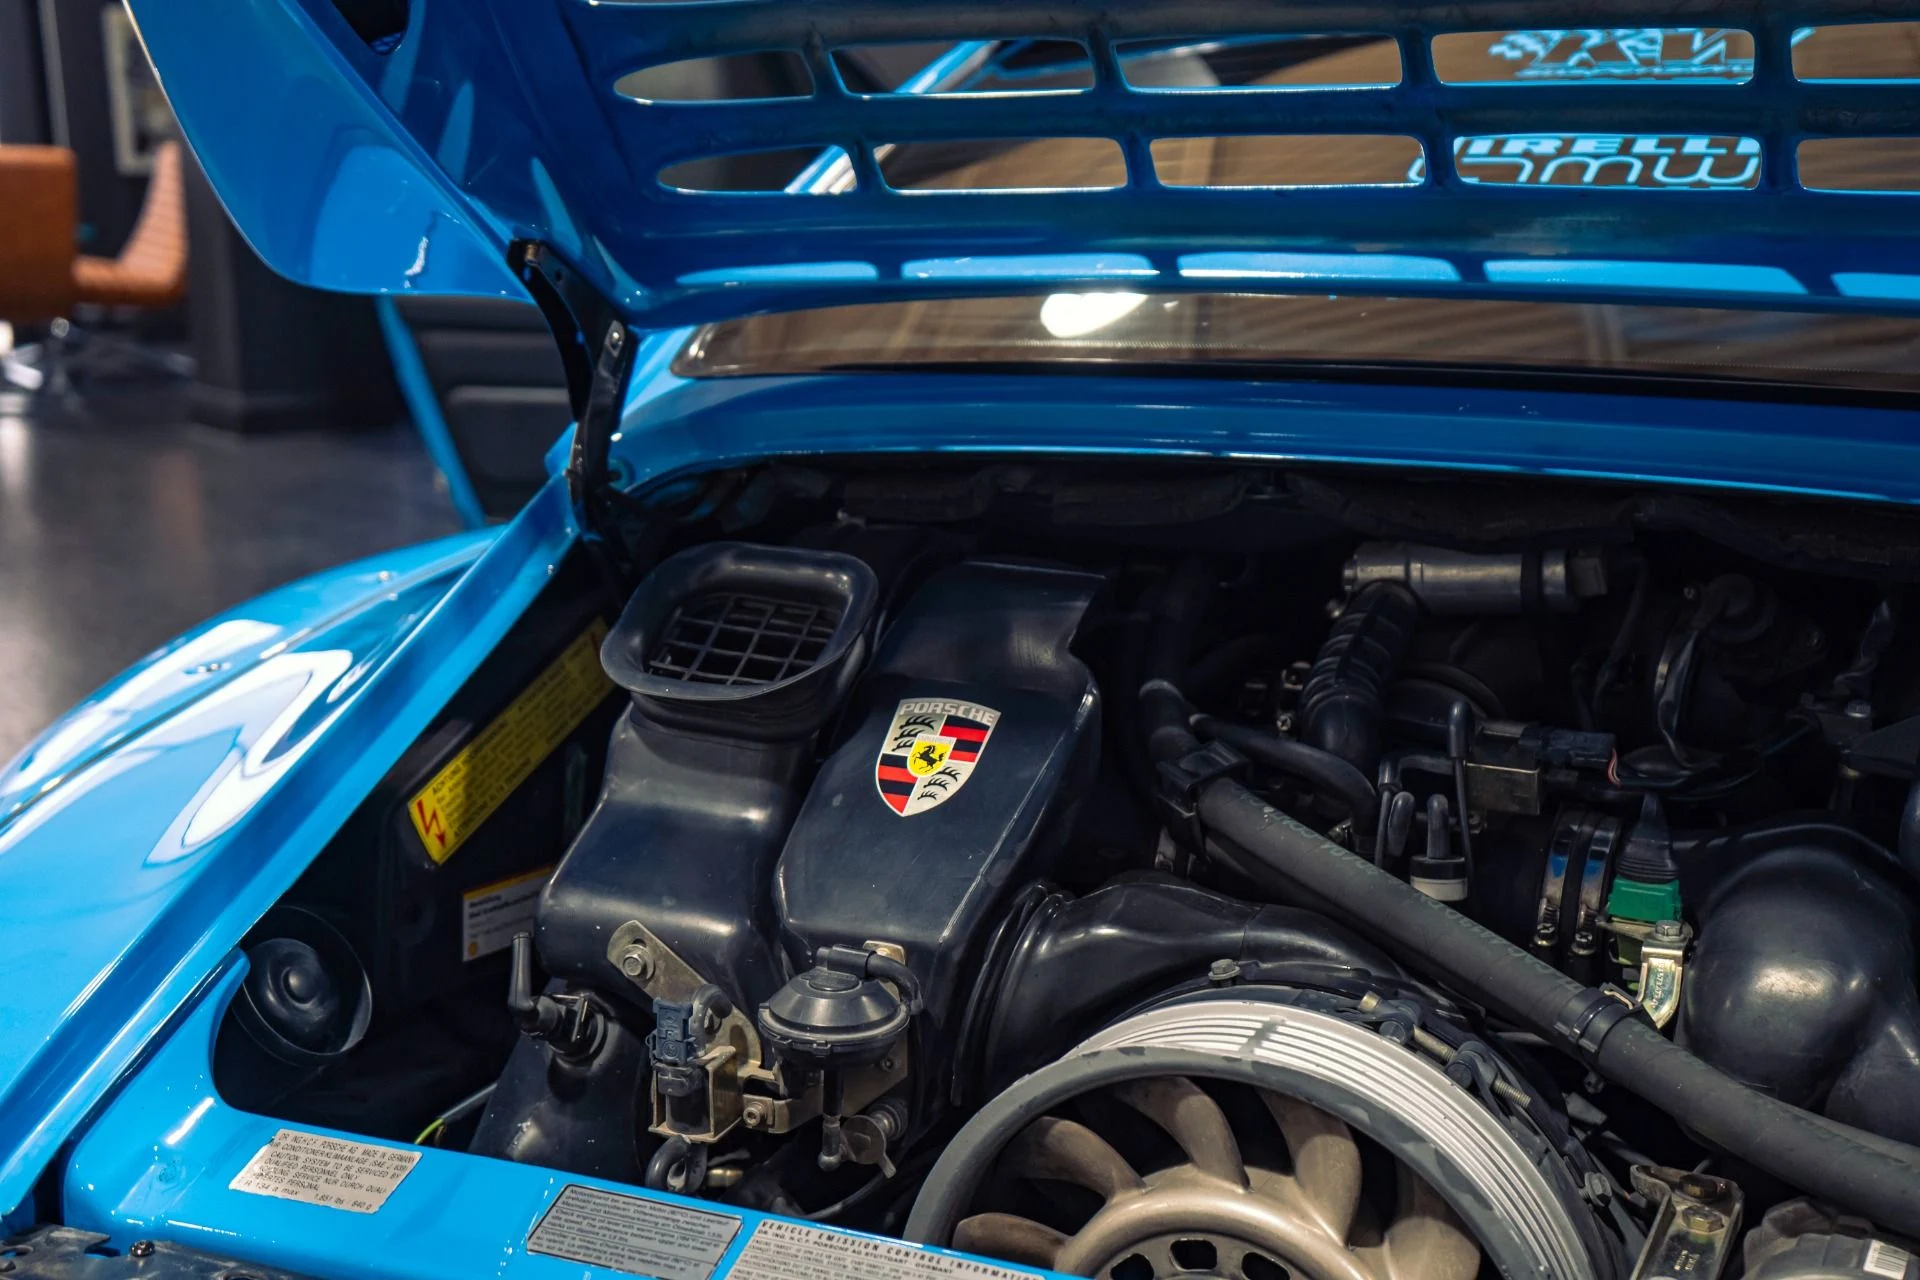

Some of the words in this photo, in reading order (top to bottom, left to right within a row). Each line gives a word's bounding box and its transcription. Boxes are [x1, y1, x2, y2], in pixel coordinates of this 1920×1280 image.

[900, 702, 996, 724] PORSCHE
[762, 1220, 810, 1236] VEHICLE
[819, 1232, 879, 1251] EMISSION
[888, 1246, 942, 1264] CONTROL
